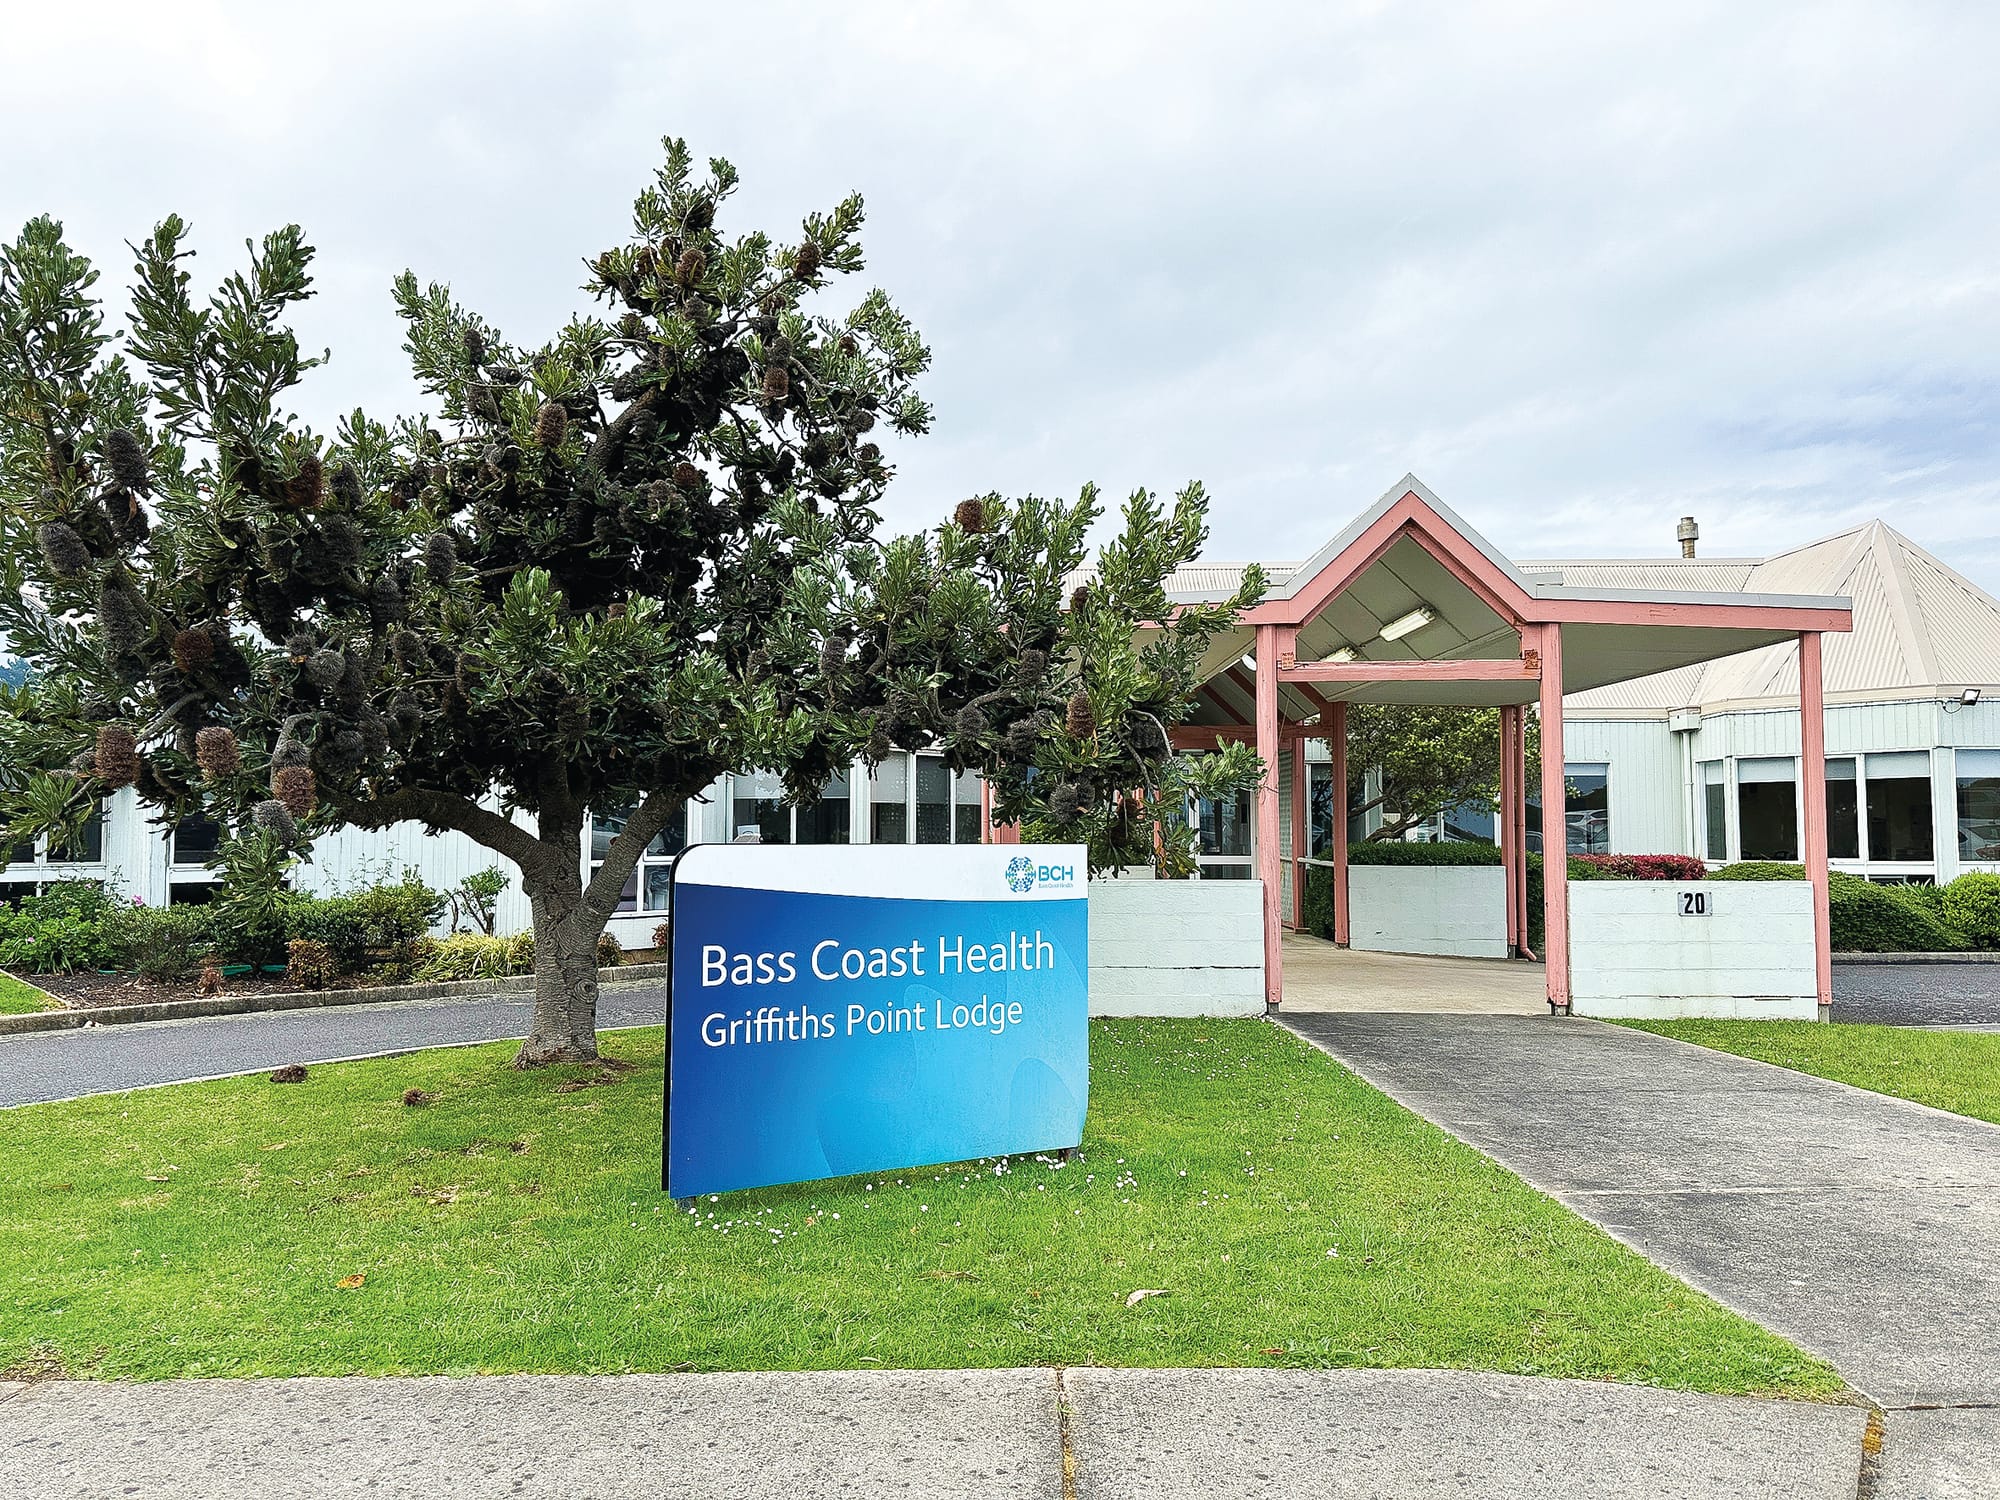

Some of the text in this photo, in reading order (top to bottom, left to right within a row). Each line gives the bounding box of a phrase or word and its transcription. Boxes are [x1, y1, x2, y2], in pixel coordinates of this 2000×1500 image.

[1038, 865, 1074, 881] BCH
[1683, 892, 1705, 914] 20
[702, 930, 1055, 987] Bass Coast Health
[701, 994, 1024, 1047] Griffiths Point Lodge
